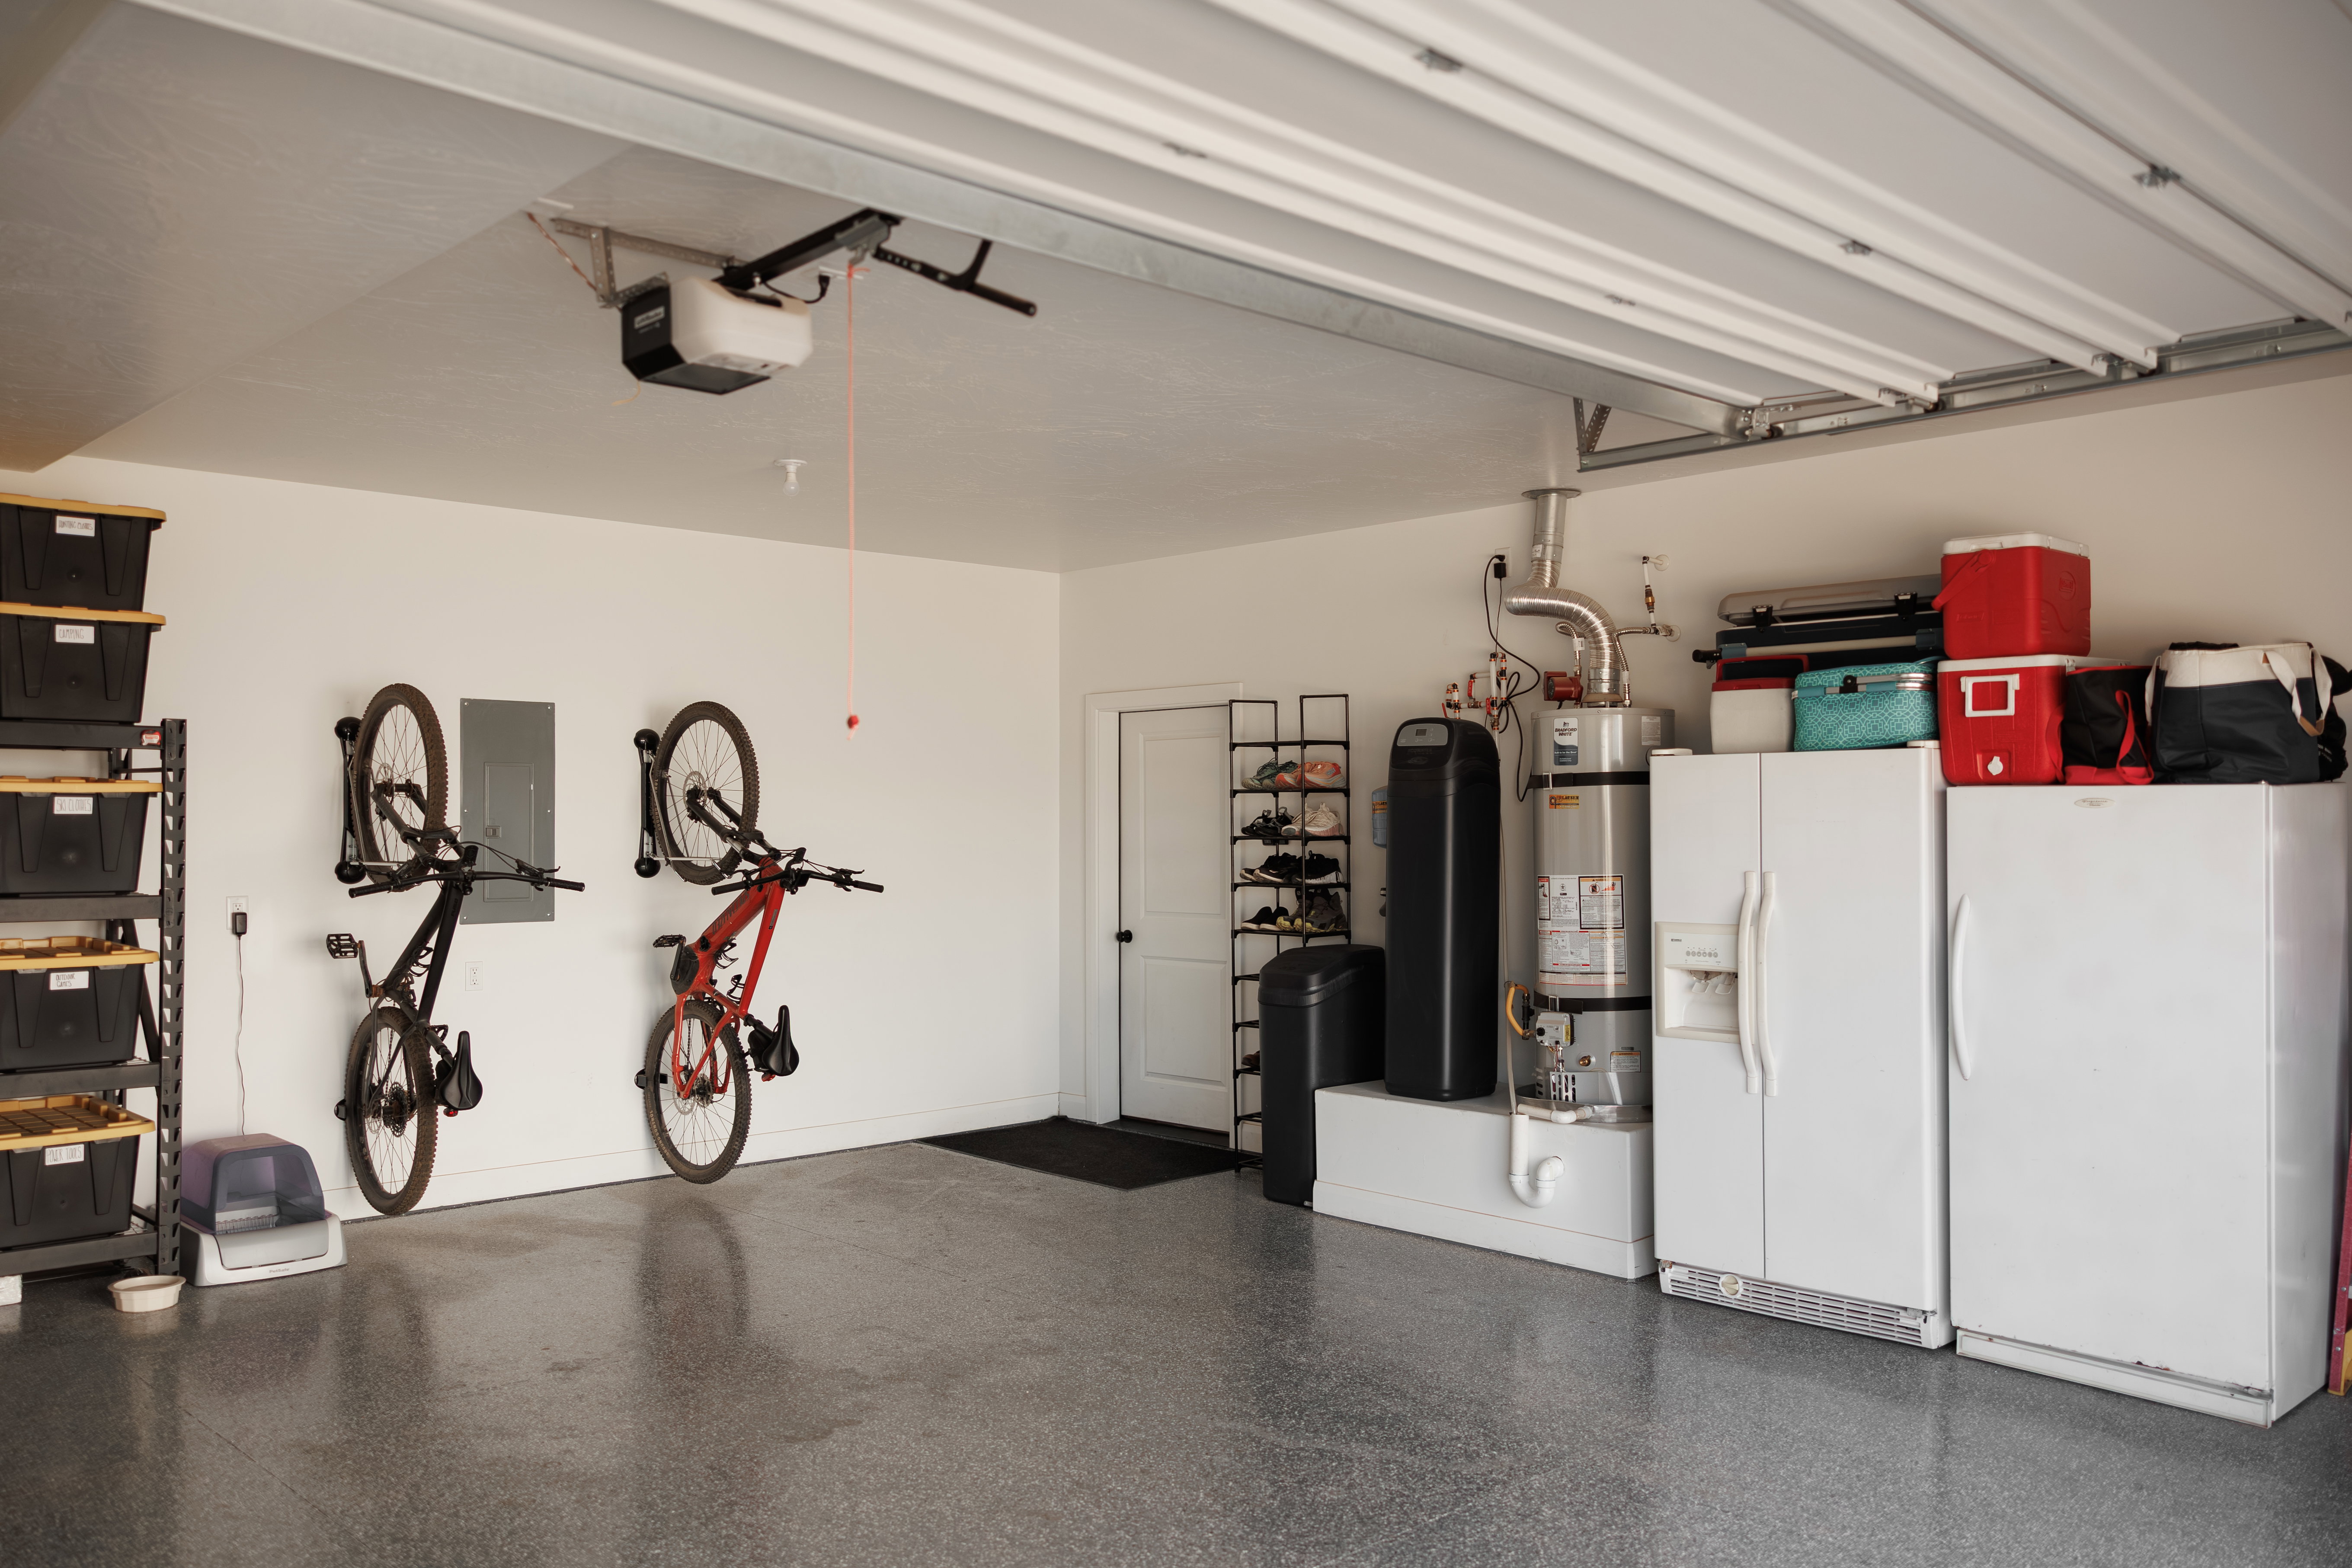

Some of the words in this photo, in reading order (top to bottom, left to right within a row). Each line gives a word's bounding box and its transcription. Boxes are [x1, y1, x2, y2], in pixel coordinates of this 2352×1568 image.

[58, 520, 76, 528] HUNTING
[59, 628, 84, 640] CAMPING
[56, 799, 66, 812] SKI
[68, 799, 91, 812] CLOTHES
[650, 1110, 659, 1136] CONTROL
[657, 1136, 669, 1156] GROUND
[47, 1149, 64, 1163] POWER
[66, 1146, 82, 1160] TOOLS
